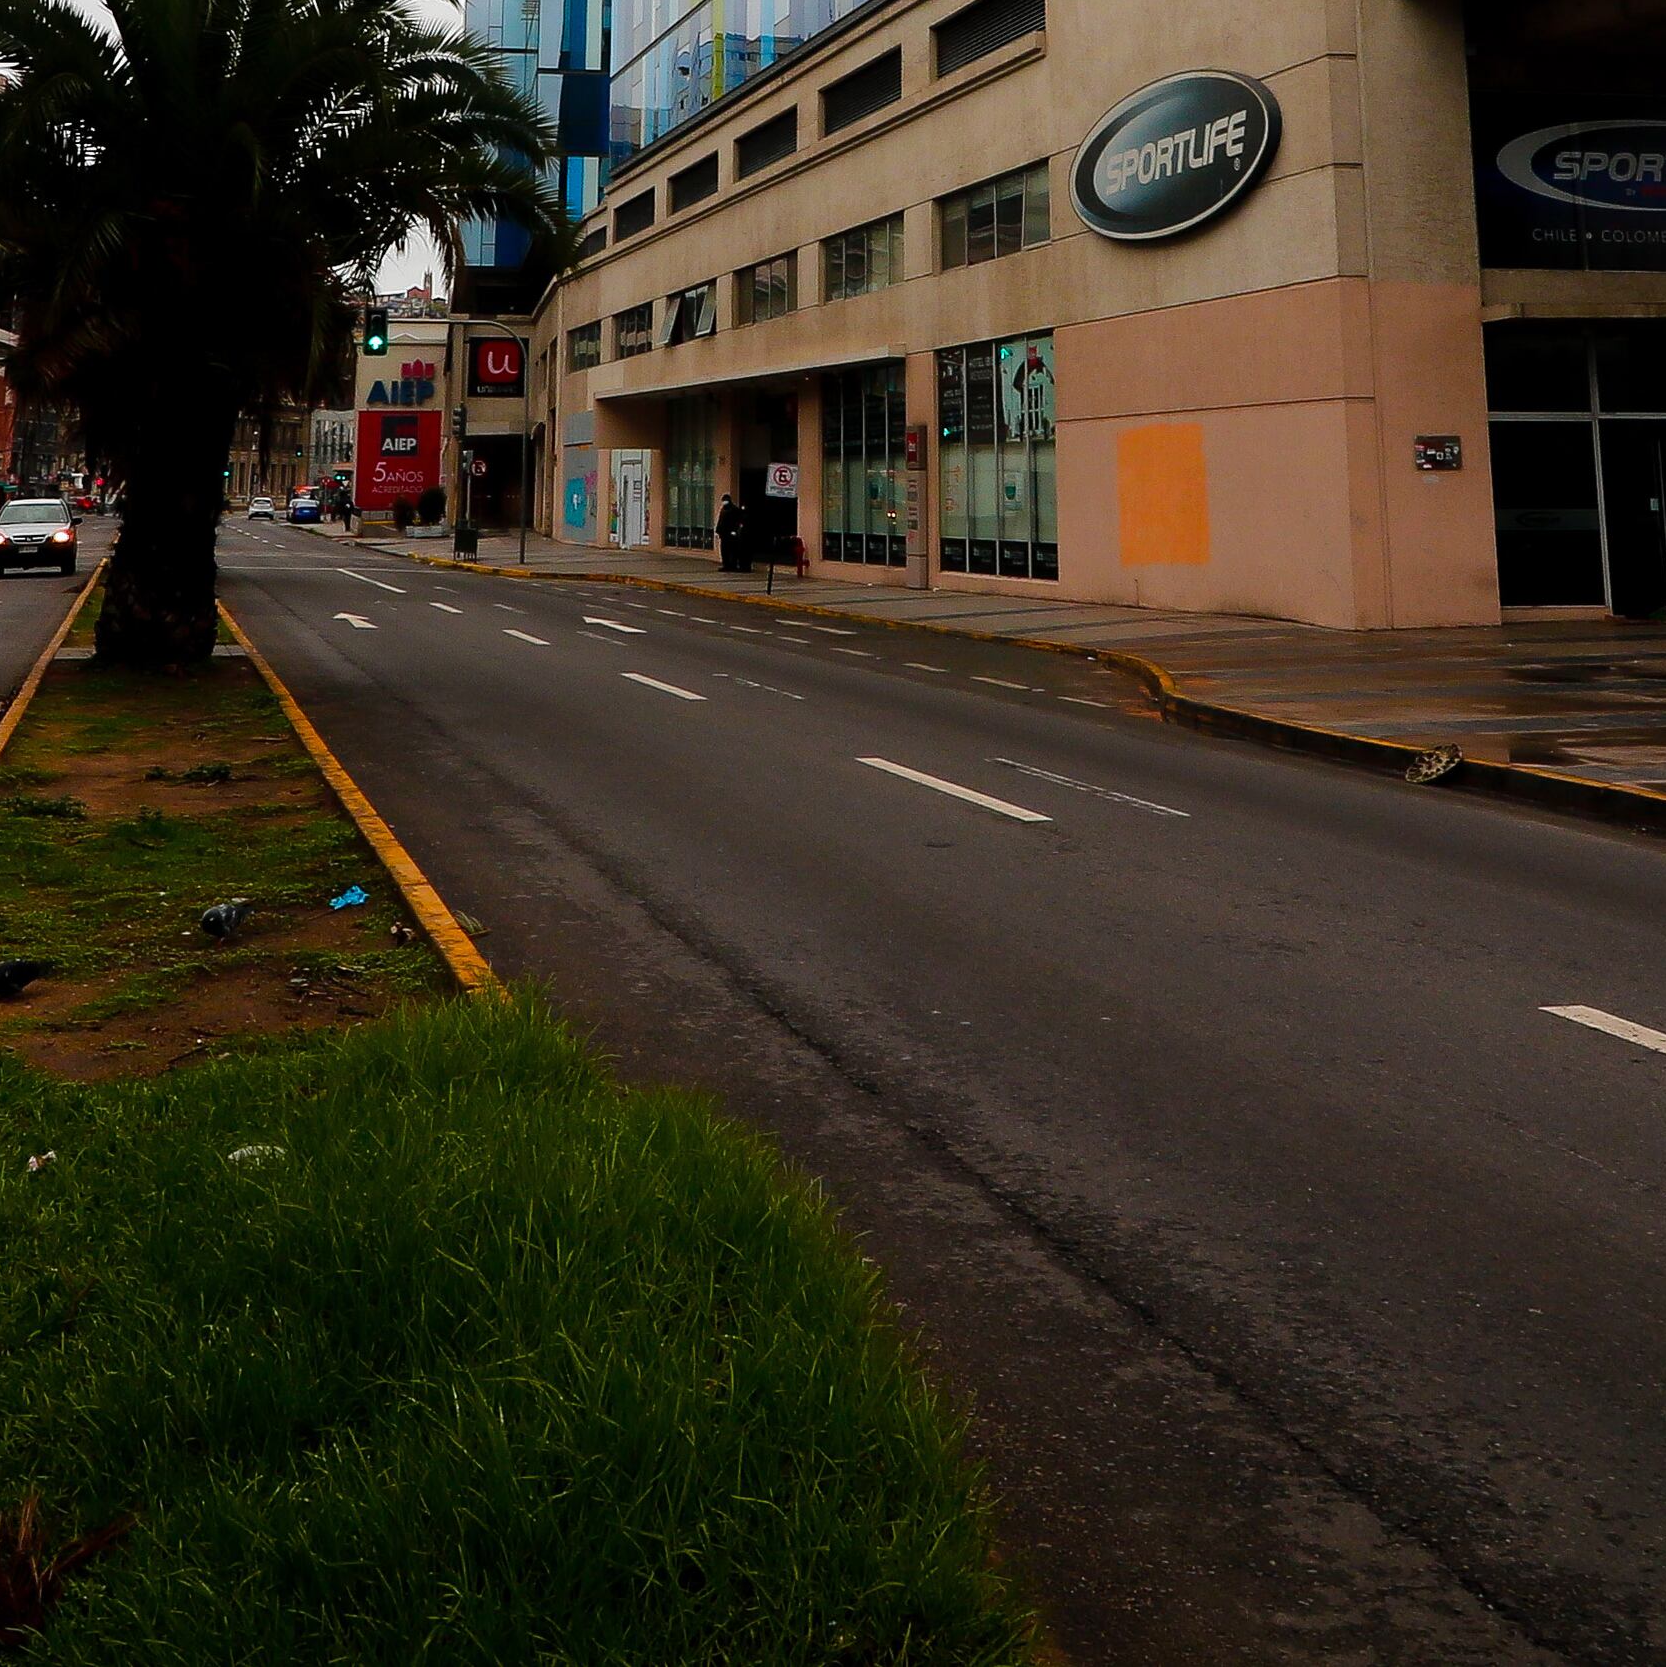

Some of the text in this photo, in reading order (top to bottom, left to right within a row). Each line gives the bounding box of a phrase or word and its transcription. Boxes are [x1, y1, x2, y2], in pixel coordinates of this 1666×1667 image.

[1103, 107, 1248, 197] SPORTLIFE
[1531, 228, 1579, 243] CHILE
[367, 380, 434, 405] AIEP
[382, 438, 417, 451] AIEP
